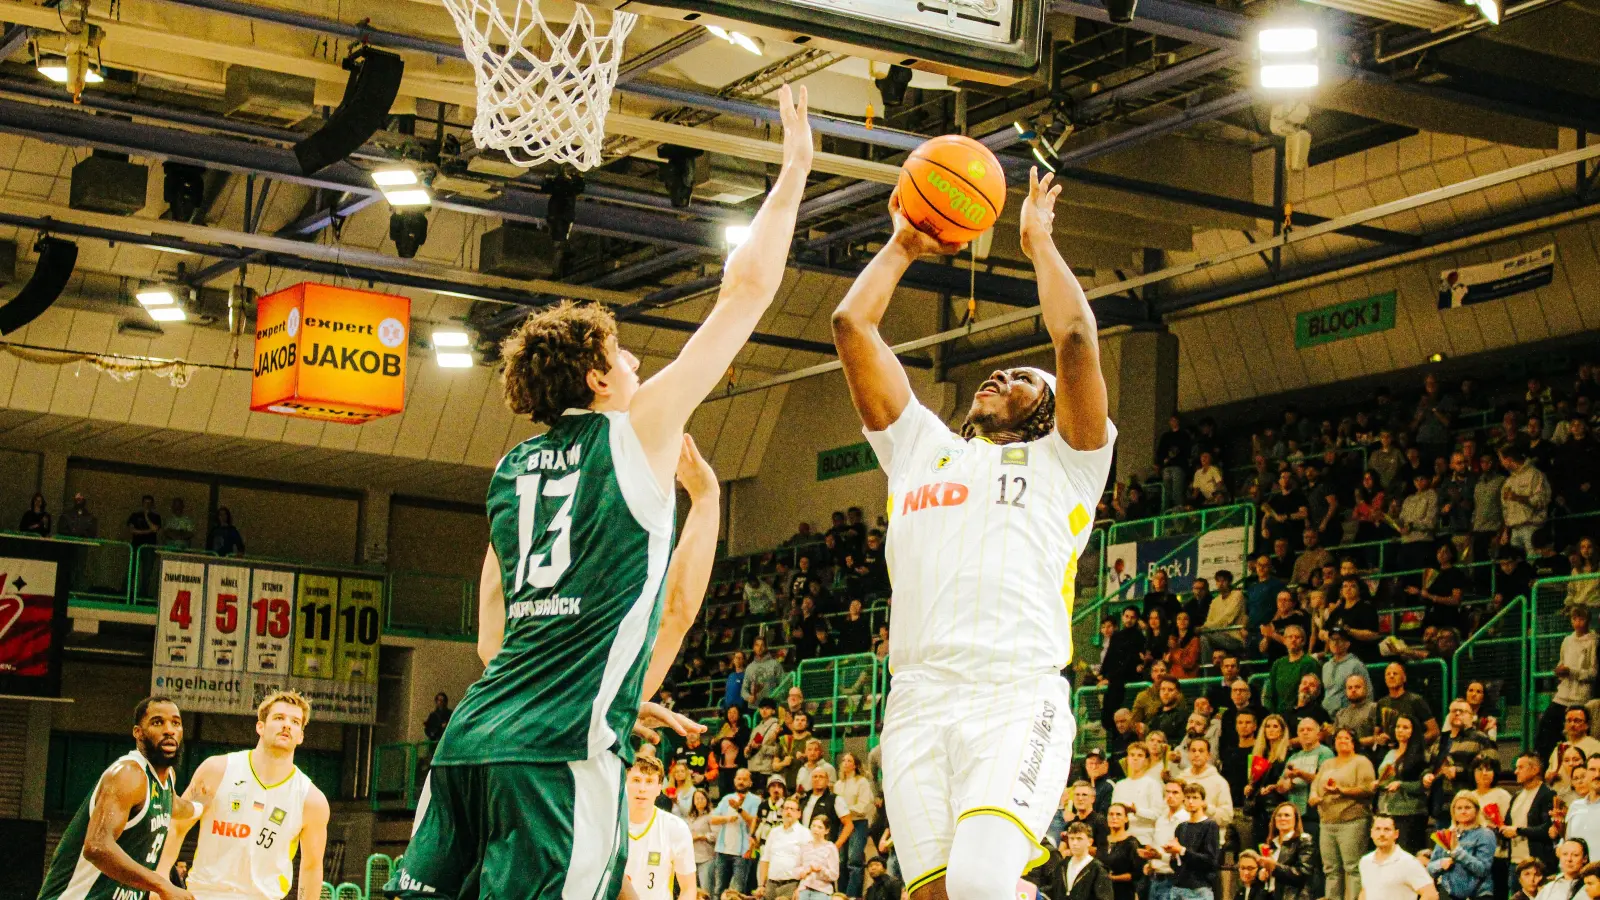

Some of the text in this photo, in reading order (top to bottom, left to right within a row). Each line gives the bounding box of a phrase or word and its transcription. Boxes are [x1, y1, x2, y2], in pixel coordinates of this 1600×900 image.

[927, 170, 986, 225] Wilson
[256, 321, 286, 340] expert
[305, 317, 374, 335] expert
[1308, 302, 1380, 337] BLOCK J
[255, 342, 297, 378] JAKOB
[303, 343, 402, 377] JAKOB
[823, 451, 860, 472] BLOCK
[902, 482, 969, 516] NKD
[996, 474, 1027, 508] 12
[515, 469, 581, 593] 13
[1183, 557, 1191, 577] J
[169, 589, 192, 629] 4
[215, 593, 238, 633] 5
[252, 597, 290, 639] 13
[301, 602, 332, 641] 11
[340, 606, 379, 646] 10
[156, 676, 240, 692] engelhardt
[690, 756, 705, 766] 30
[212, 820, 251, 838] NKD
[256, 827, 276, 849] 55
[647, 872, 656, 890] 3
